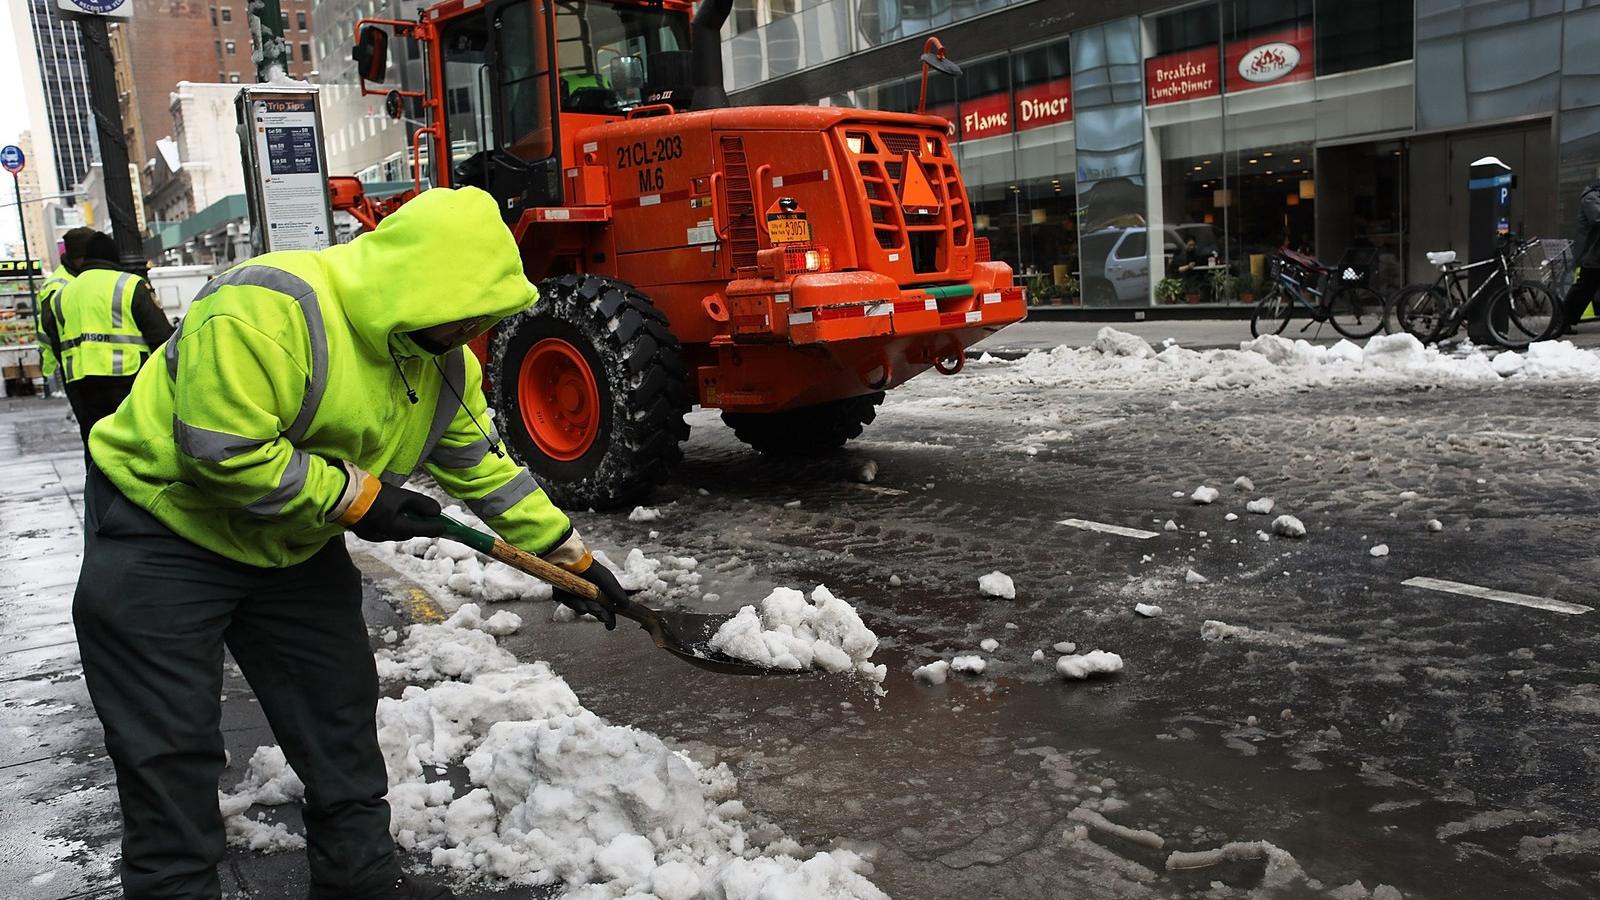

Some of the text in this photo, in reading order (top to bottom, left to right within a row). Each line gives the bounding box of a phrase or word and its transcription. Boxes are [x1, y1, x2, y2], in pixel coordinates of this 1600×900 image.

[1156, 62, 1206, 82] Breakfast
[268, 102, 305, 111] Trip Tips
[964, 111, 1008, 132] Flame
[1020, 97, 1068, 121] Diner
[617, 136, 682, 169] 21CL-203
[639, 168, 664, 192] M.6
[1501, 187, 1508, 204] P
[790, 221, 805, 235] 3057
